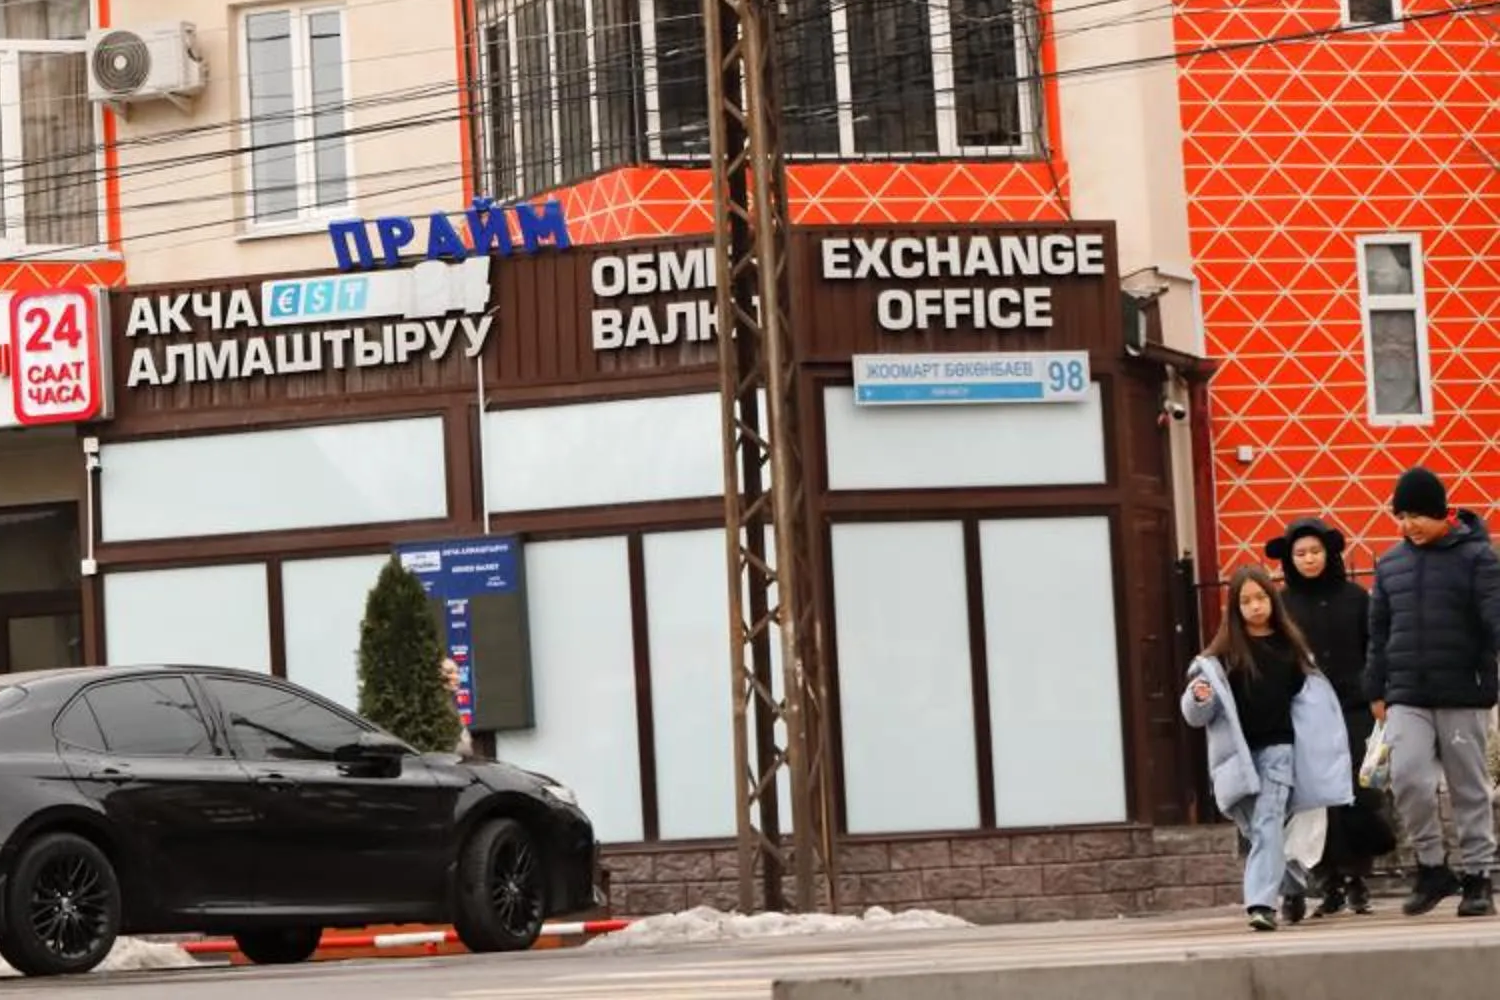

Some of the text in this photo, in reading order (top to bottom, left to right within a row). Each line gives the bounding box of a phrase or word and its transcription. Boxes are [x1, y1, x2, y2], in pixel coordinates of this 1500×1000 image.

[328, 197, 571, 271] ПРАЙМ
[591, 246, 758, 298] ОБМ
[821, 235, 1104, 279] EXCHANGE
[25, 304, 81, 351] 24
[126, 289, 260, 338] АКЧА
[877, 287, 1053, 330] OFFICE
[27, 360, 84, 385] СААТ
[127, 315, 493, 388] АЛМАШТЫРУУ
[867, 362, 940, 379] ЖООМАРТ
[27, 383, 85, 405] ЧАСА
[1048, 359, 1084, 392] 98
